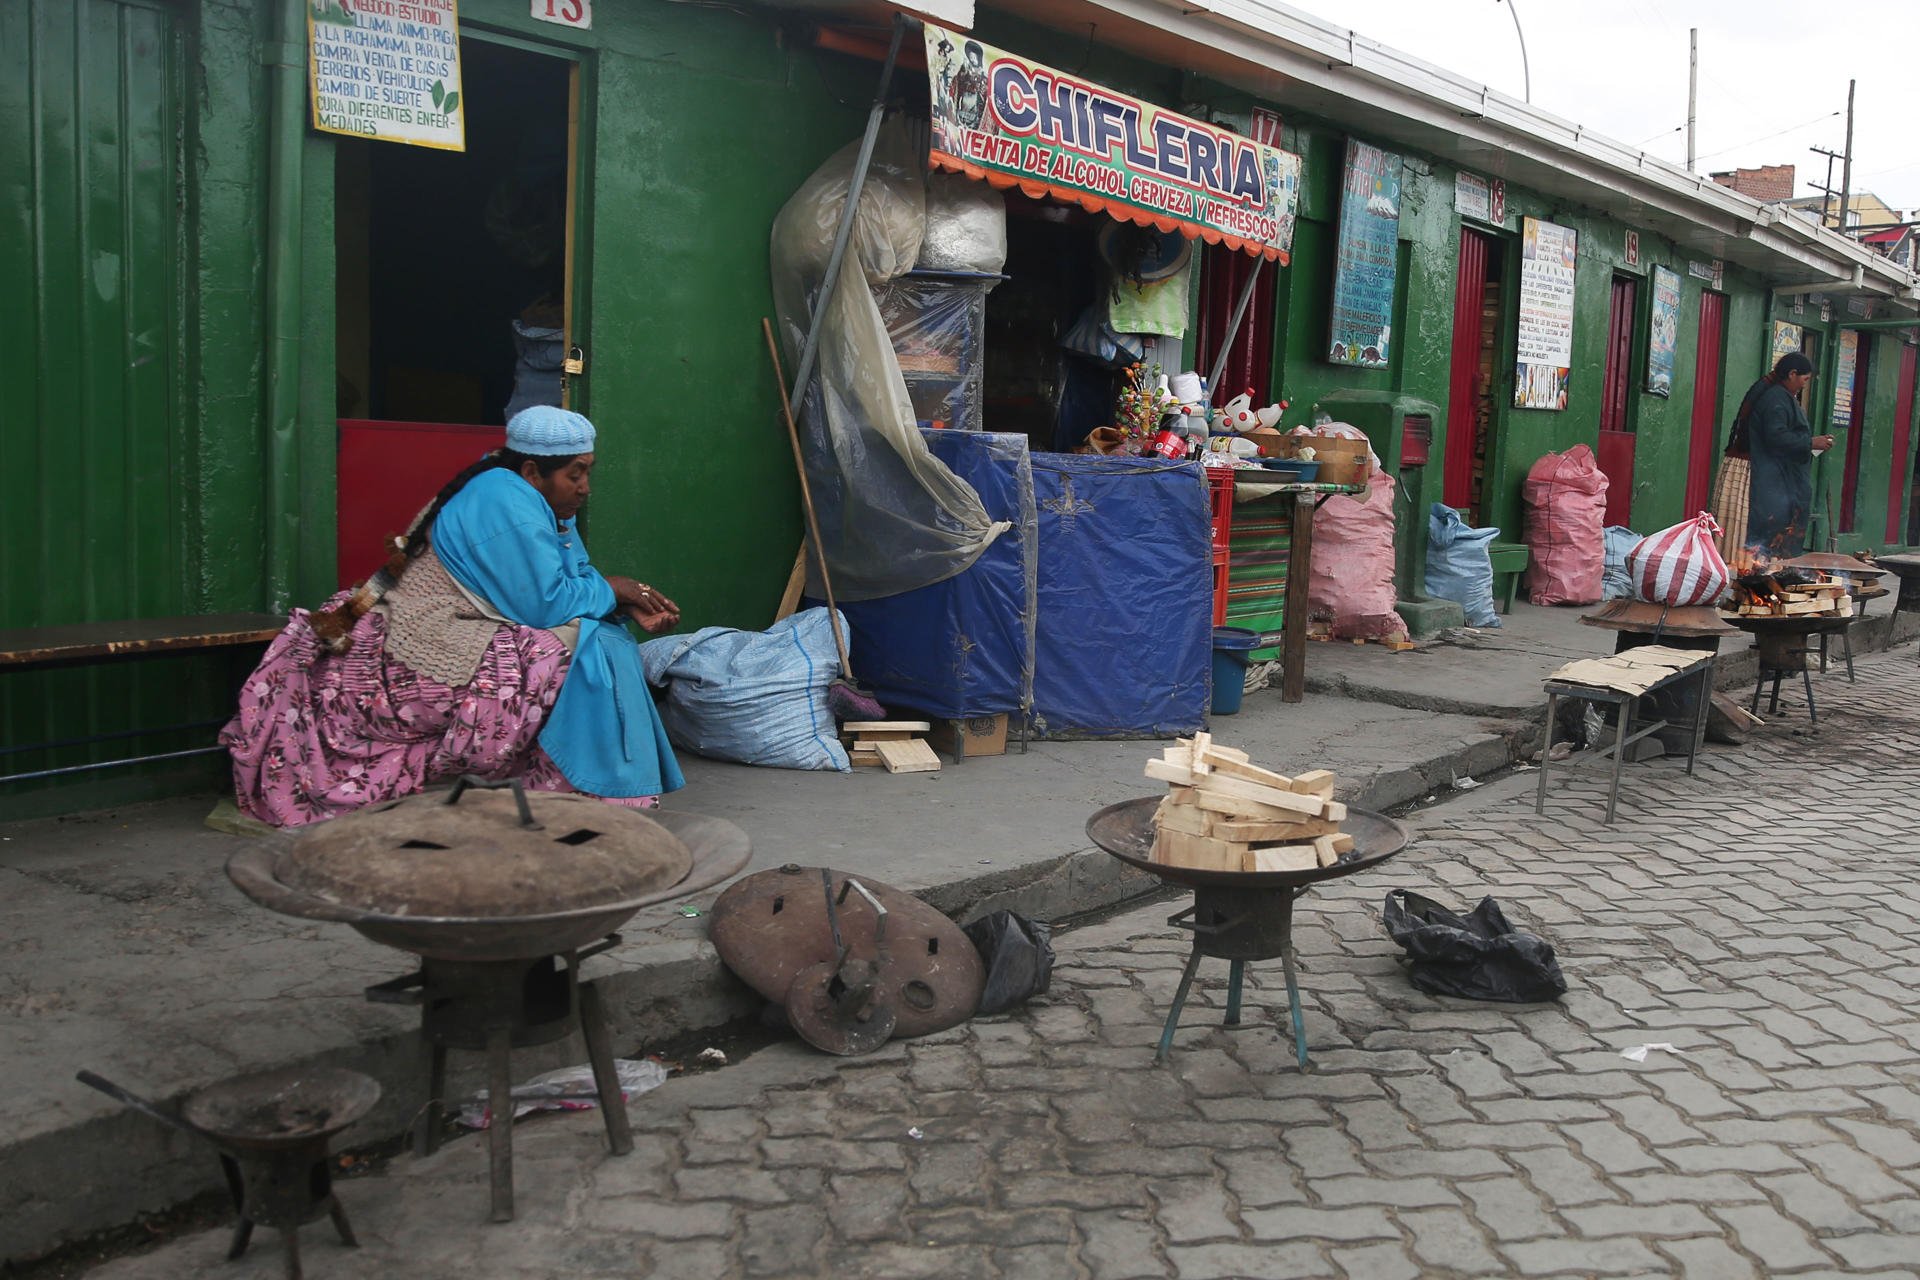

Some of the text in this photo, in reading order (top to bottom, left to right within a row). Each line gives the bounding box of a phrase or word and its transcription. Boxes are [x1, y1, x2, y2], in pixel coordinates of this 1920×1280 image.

[353, 12, 457, 46] LLAMA ANIMO PAGA
[399, 4, 442, 26] ESTUDIO
[313, 41, 449, 77] COMPRA VENTA DE CASAS
[314, 24, 457, 62] A LA PACHAMAMA PARA LA
[314, 58, 433, 93] TERRENOS VEHICULOS
[315, 77, 422, 108] CAMBIO DE SUERTE
[316, 95, 455, 128] CURA DIFERENTES ENFER-
[317, 112, 377, 136] MEDADES
[991, 64, 1264, 205] CHIFLERIA
[1256, 114, 1278, 146] 17
[958, 128, 1278, 240] VENTA DE ALCOHOL CERVEZA Y REFRESCOS
[1491, 178, 1505, 224] 18
[1626, 231, 1638, 264] 19
